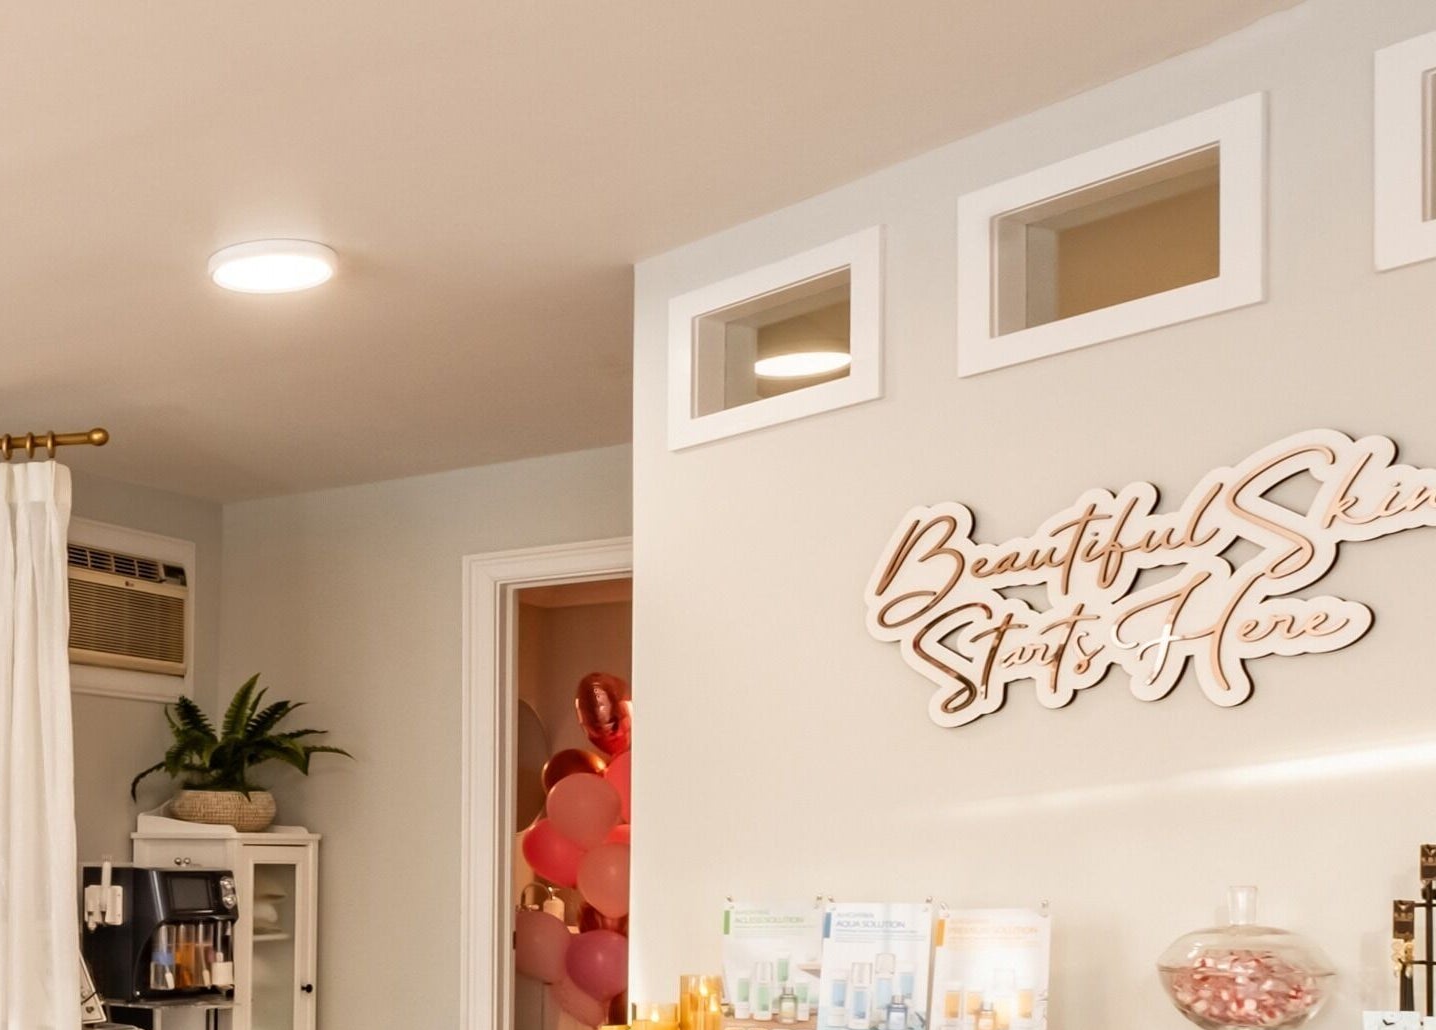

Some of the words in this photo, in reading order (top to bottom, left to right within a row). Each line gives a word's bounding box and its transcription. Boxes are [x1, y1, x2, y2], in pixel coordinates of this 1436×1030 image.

[875, 482, 1223, 629] Beautiful
[911, 602, 1105, 714] Starts
[1110, 570, 1350, 692] Here
[836, 920, 861, 928] AQUA
[862, 920, 905, 929] SOLUTION
